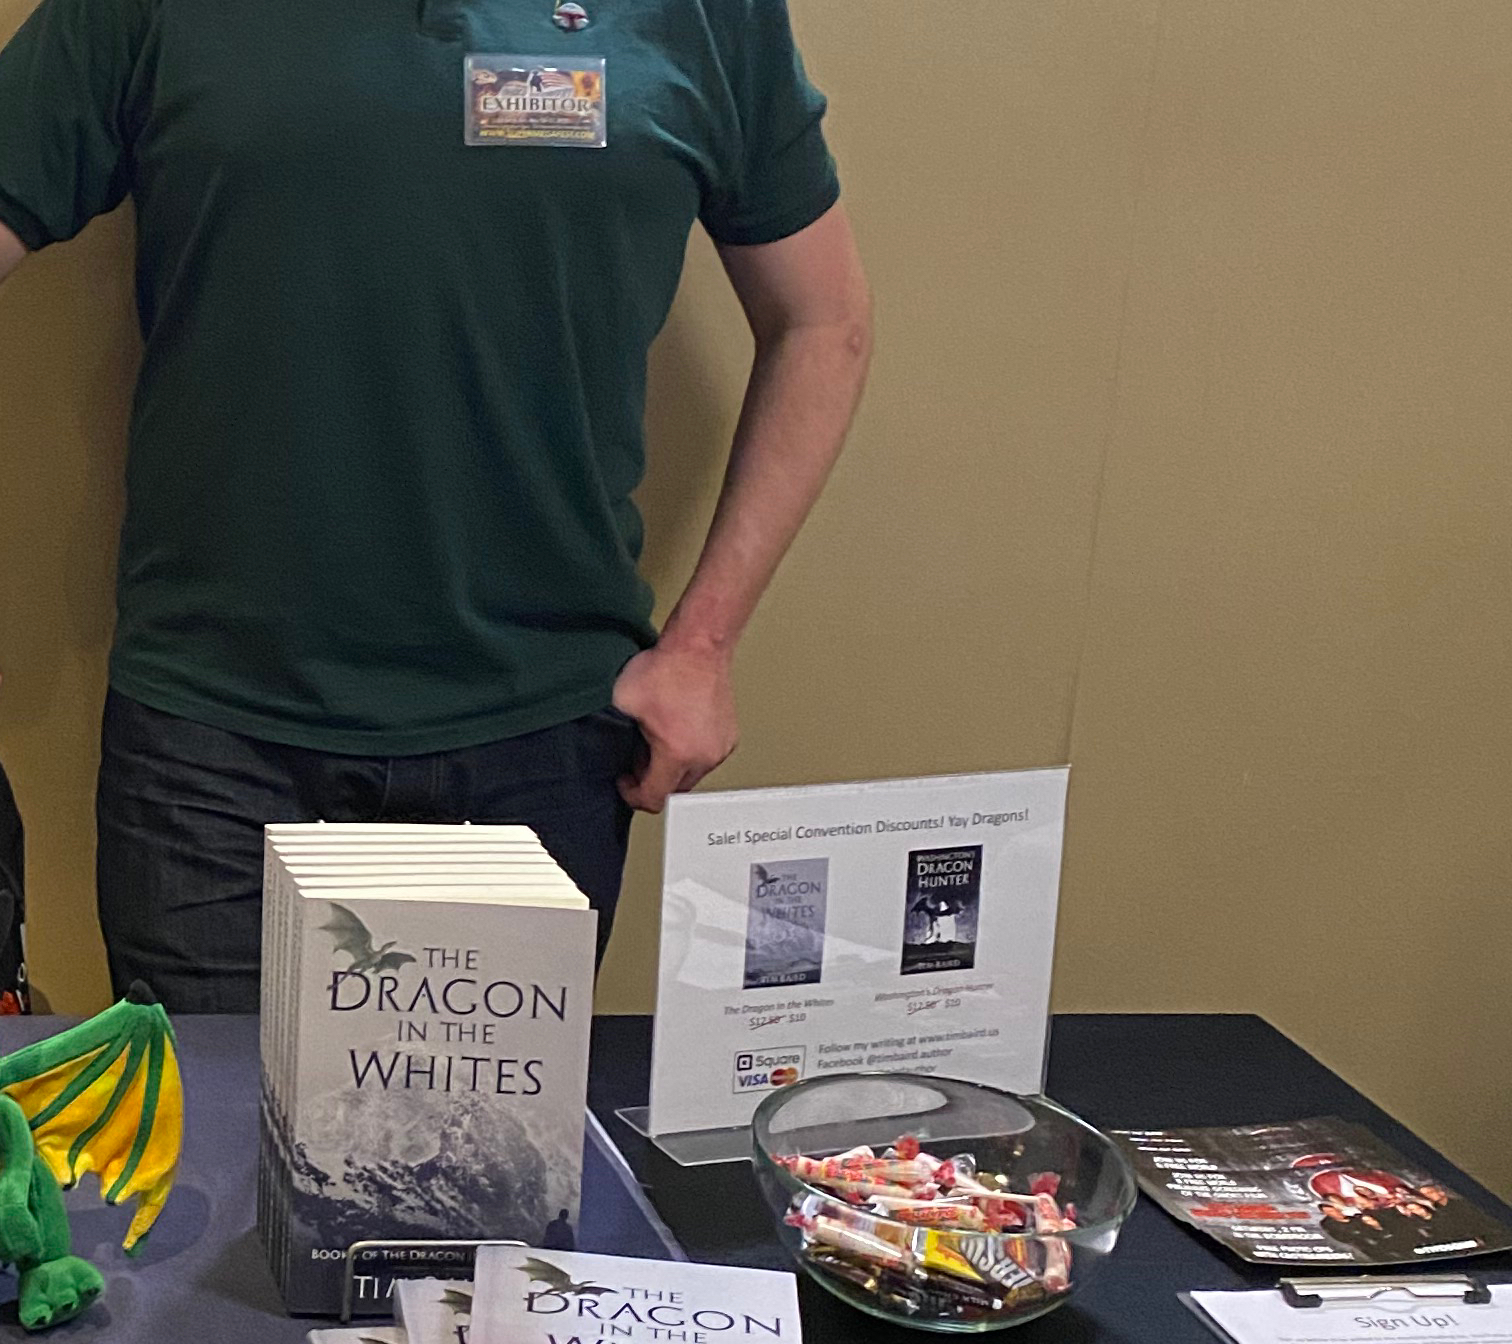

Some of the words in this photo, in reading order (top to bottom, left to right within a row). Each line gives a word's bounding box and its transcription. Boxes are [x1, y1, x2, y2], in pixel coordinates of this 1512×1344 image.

[482, 97, 589, 112] EXHIBITOR
[707, 830, 741, 846] Sale!
[744, 826, 792, 845] Special
[795, 822, 872, 839] Convention
[876, 816, 944, 833] Discounts!
[949, 816, 969, 829] Yay
[972, 808, 1029, 826] Dragons!
[917, 859, 974, 876] DRAGON
[756, 881, 821, 897] DRAGON
[918, 873, 970, 888] HUNTER
[423, 947, 479, 970] THE
[330, 970, 567, 1022] DRAGON
[397, 1020, 428, 1042] IN
[439, 1021, 496, 1045] THE
[348, 1048, 544, 1096] WHITES
[738, 1073, 768, 1087] VISA
[382, 1249, 406, 1261] THE
[409, 1249, 466, 1261] DRAGON
[623, 1286, 684, 1304] THE
[526, 1291, 781, 1338] DRAGON
[1354, 1315, 1409, 1331] Sign
[1410, 1313, 1459, 1329] Up!
[600, 1323, 632, 1338] IN
[646, 1326, 707, 1344] THE
